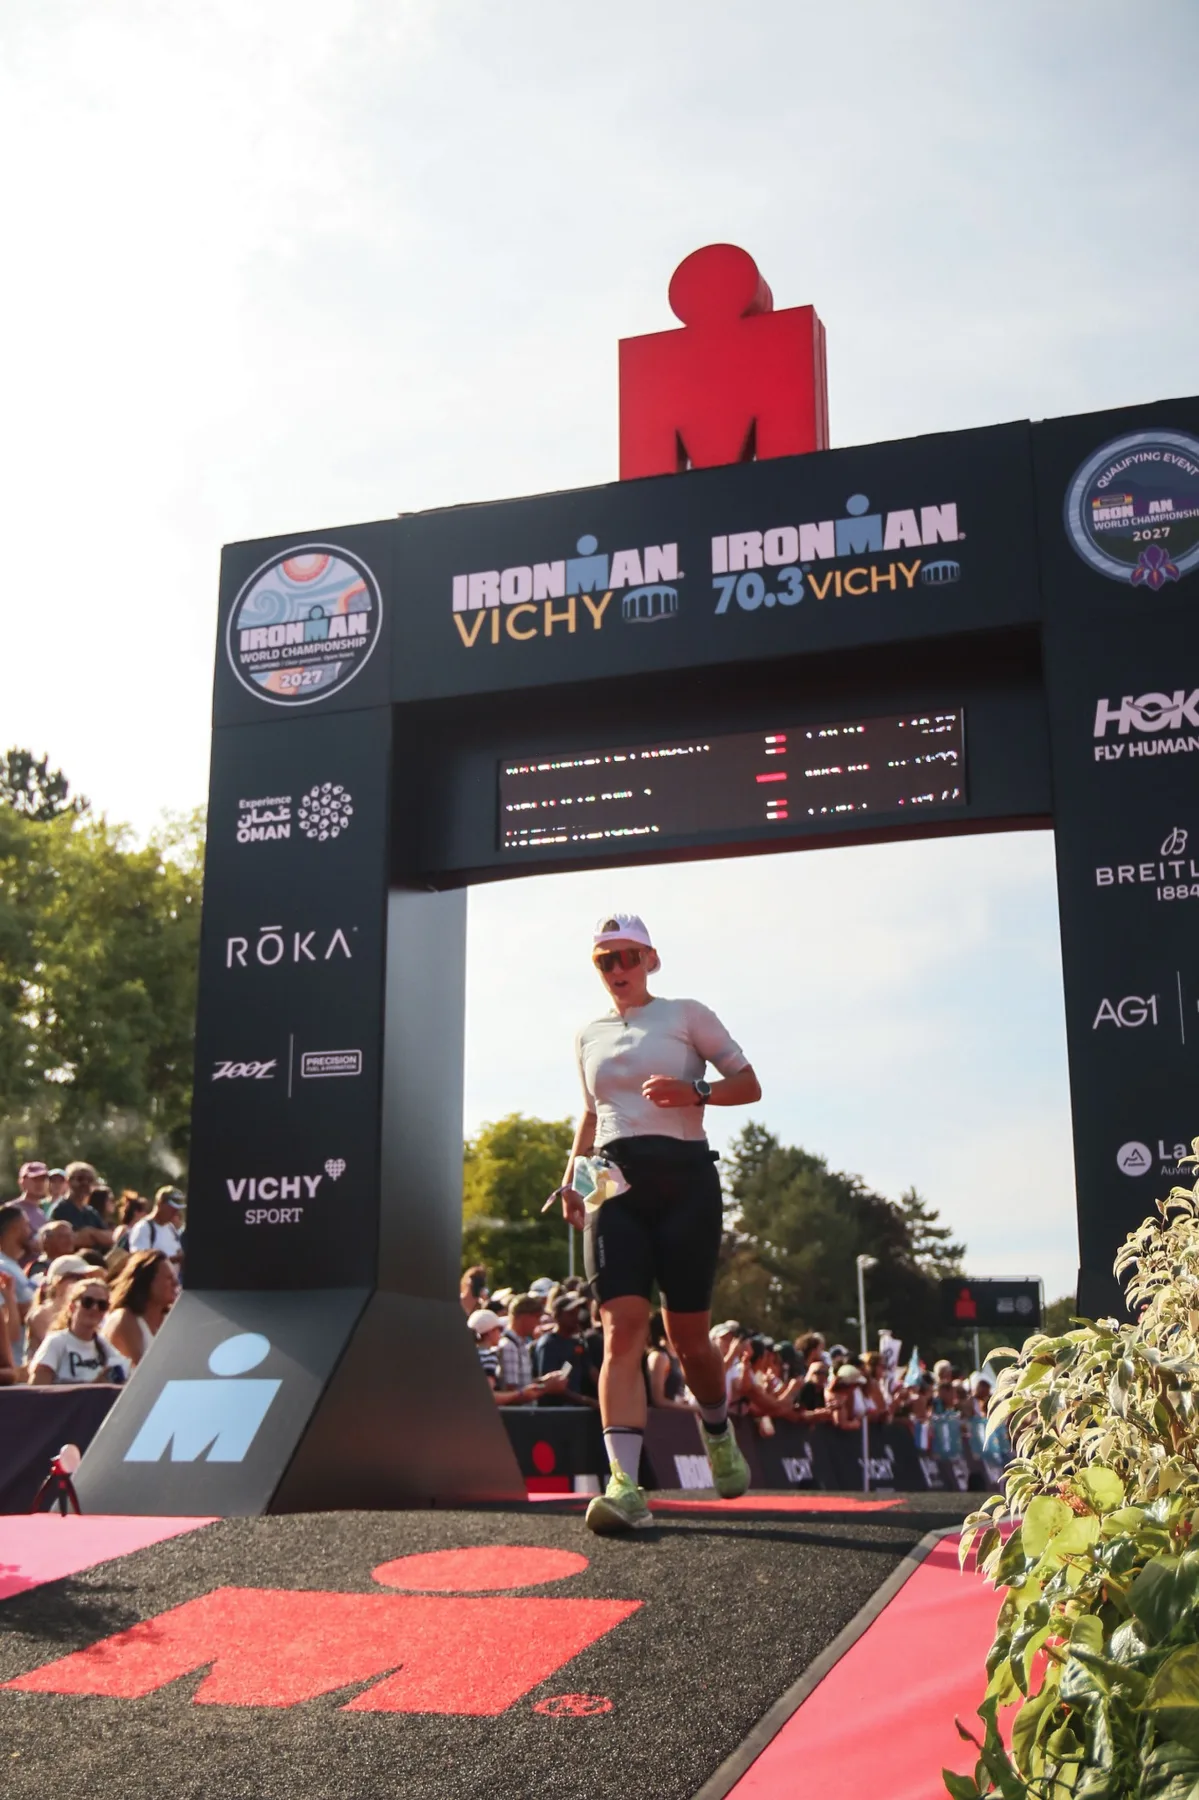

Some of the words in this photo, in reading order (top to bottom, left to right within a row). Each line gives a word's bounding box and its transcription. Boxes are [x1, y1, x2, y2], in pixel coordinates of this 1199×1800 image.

[1097, 452, 1161, 488] QUALIFYING
[1163, 453, 1199, 476] EVENT
[711, 494, 959, 574] IRONMAN
[1094, 519, 1129, 531] WORLD
[1133, 527, 1170, 541] 2027
[453, 535, 678, 612] IRONMAN
[712, 567, 804, 614] 70.3
[807, 560, 922, 600] VICHY
[240, 605, 368, 651] IRONMAN
[453, 591, 613, 648] VICHY
[240, 650, 280, 664] WORLD
[282, 637, 367, 658] CHAMPIONSHIP
[280, 671, 323, 688] 2027
[1094, 744, 1124, 761] FLY
[239, 796, 292, 810] Experience
[236, 824, 291, 843] OMAN
[1157, 885, 1199, 901] 1884
[1092, 994, 1158, 1030] AG1
[306, 1055, 357, 1066] PRECISION
[1158, 1140, 1187, 1160] La
[226, 1175, 323, 1201] VICHY
[245, 1208, 304, 1225] SPORT
